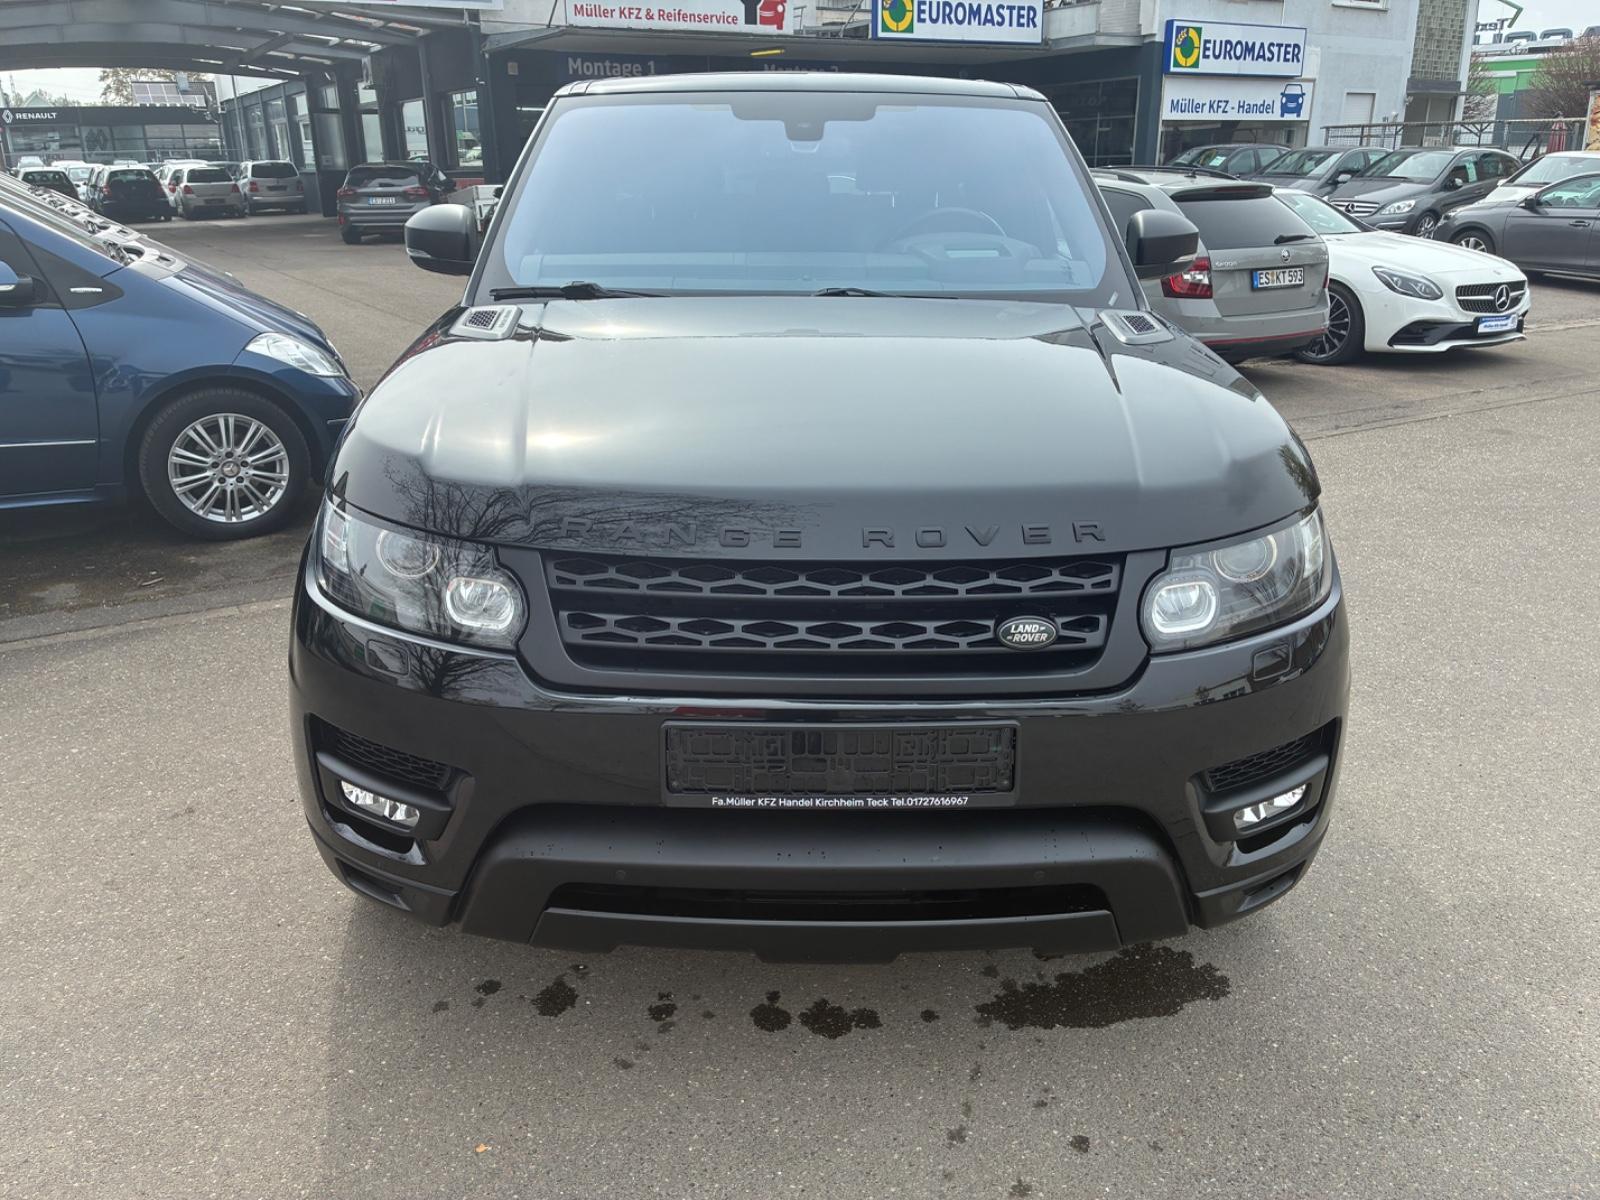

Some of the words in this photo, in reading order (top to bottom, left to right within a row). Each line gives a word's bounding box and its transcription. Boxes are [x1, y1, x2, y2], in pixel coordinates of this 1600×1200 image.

[574, 3, 616, 19] Müller
[618, 6, 642, 20] KFZ
[645, 9, 655, 20] &
[657, 8, 739, 25] Reifenservice
[917, 0, 1037, 29] EUROMASTER
[1202, 38, 1302, 63] EUROMASTER
[567, 57, 642, 77] Montage
[648, 61, 656, 75] 1
[15, 112, 57, 120] RENAULT
[1170, 98, 1206, 114] Müller
[1208, 100, 1229, 114] KFZ
[1237, 100, 1275, 114] Handel
[1258, 270, 1270, 286] ES
[1275, 270, 1287, 284] KT
[1288, 269, 1303, 283] 593
[558, 516, 801, 549] RANGE
[862, 520, 1106, 549] ROVER
[758, 798, 777, 807] KFZ
[779, 798, 813, 807] Handel
[815, 798, 864, 807] Kirchheim
[866, 797, 889, 807] Teck
